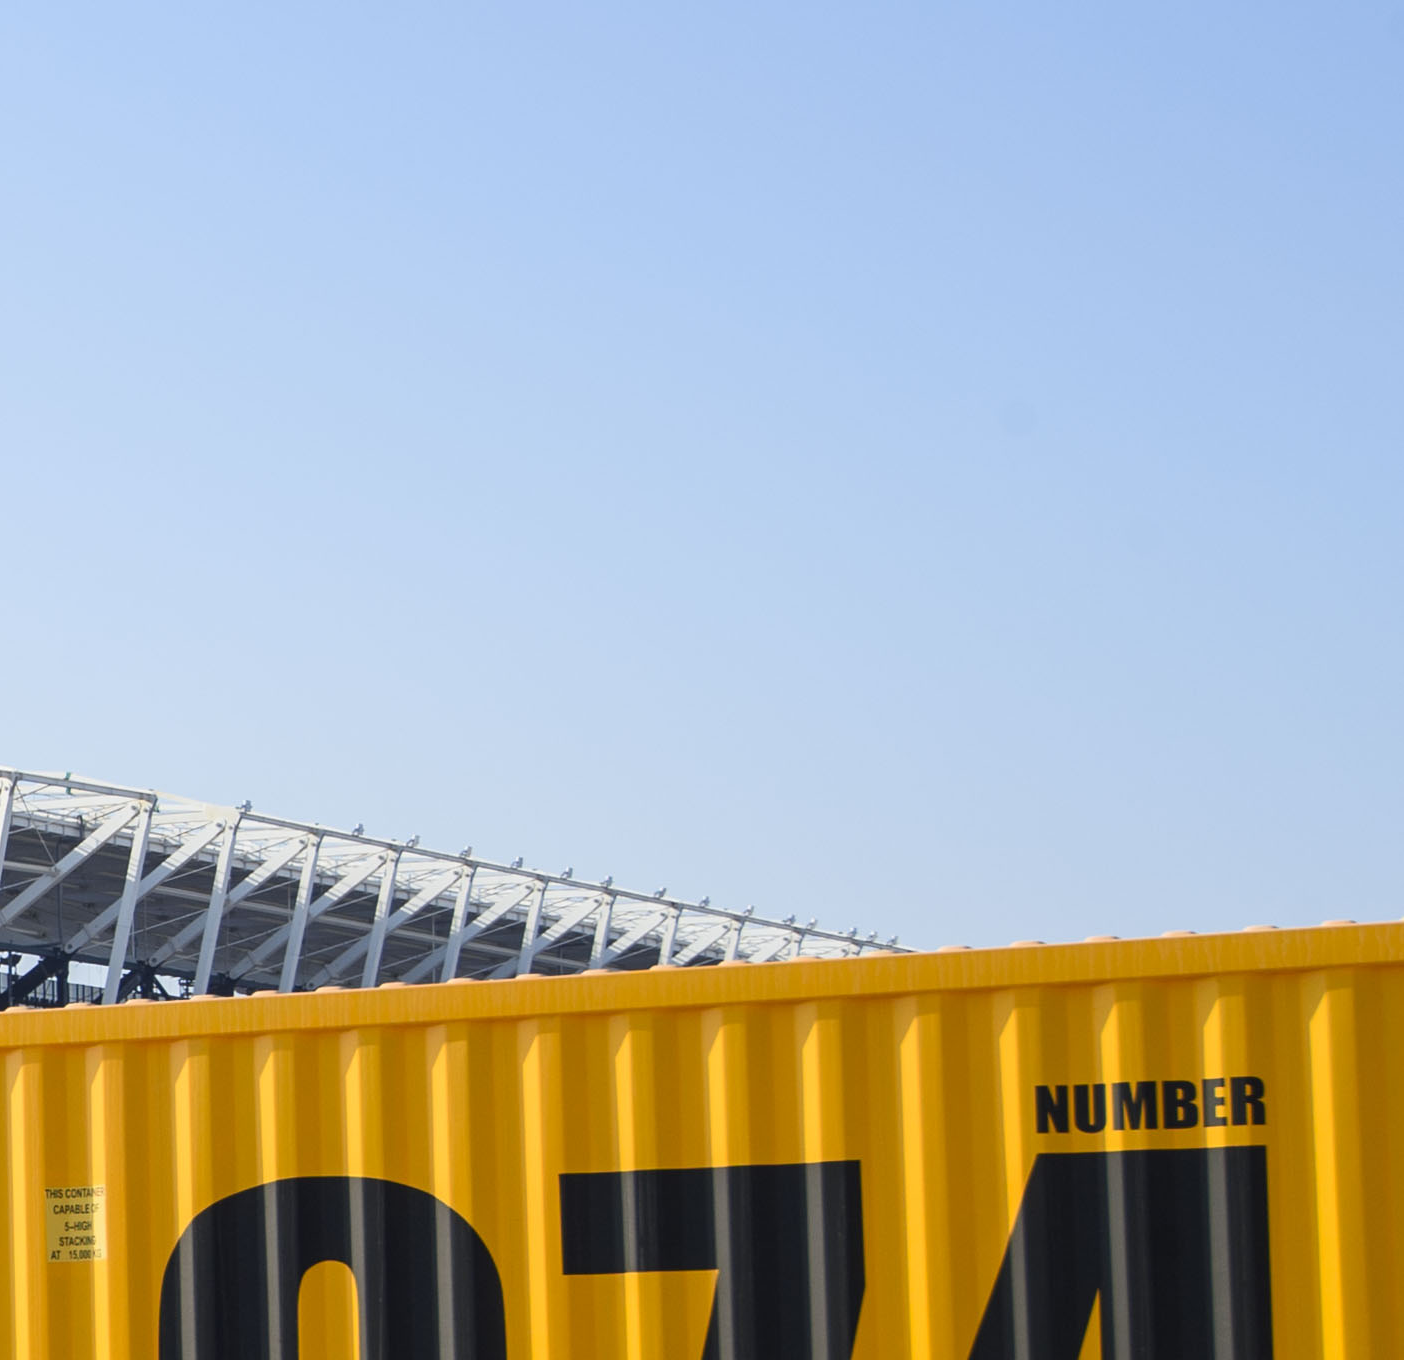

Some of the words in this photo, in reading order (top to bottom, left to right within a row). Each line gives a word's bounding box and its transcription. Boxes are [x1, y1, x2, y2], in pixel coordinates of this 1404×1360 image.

[1035, 1076, 1266, 1134] NUMBER
[45, 1188, 64, 1199] THIS
[53, 1204, 90, 1214] CAPABLE
[51, 1250, 61, 1260] AT
